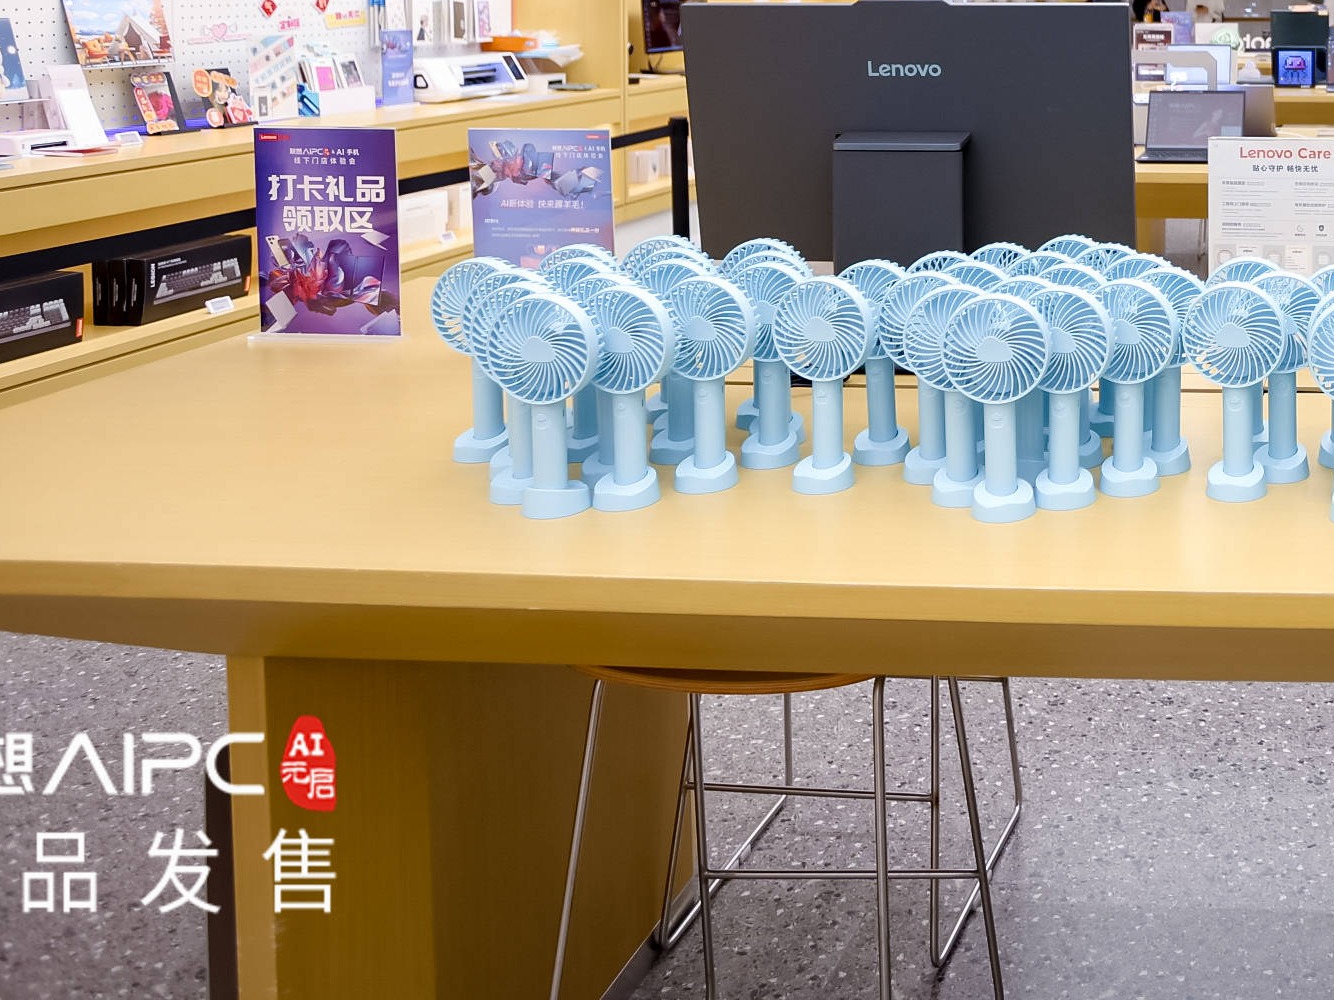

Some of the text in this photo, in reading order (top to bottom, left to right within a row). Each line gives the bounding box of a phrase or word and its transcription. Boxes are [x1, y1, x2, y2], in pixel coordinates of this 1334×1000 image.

[867, 61, 942, 77] Lenovo
[336, 148, 345, 156] AI
[1240, 147, 1332, 159] Lenovo Care
[1287, 165, 1319, 173] 畅快无忧
[268, 174, 386, 203] 打卡礼品
[282, 206, 374, 233] 领取区
